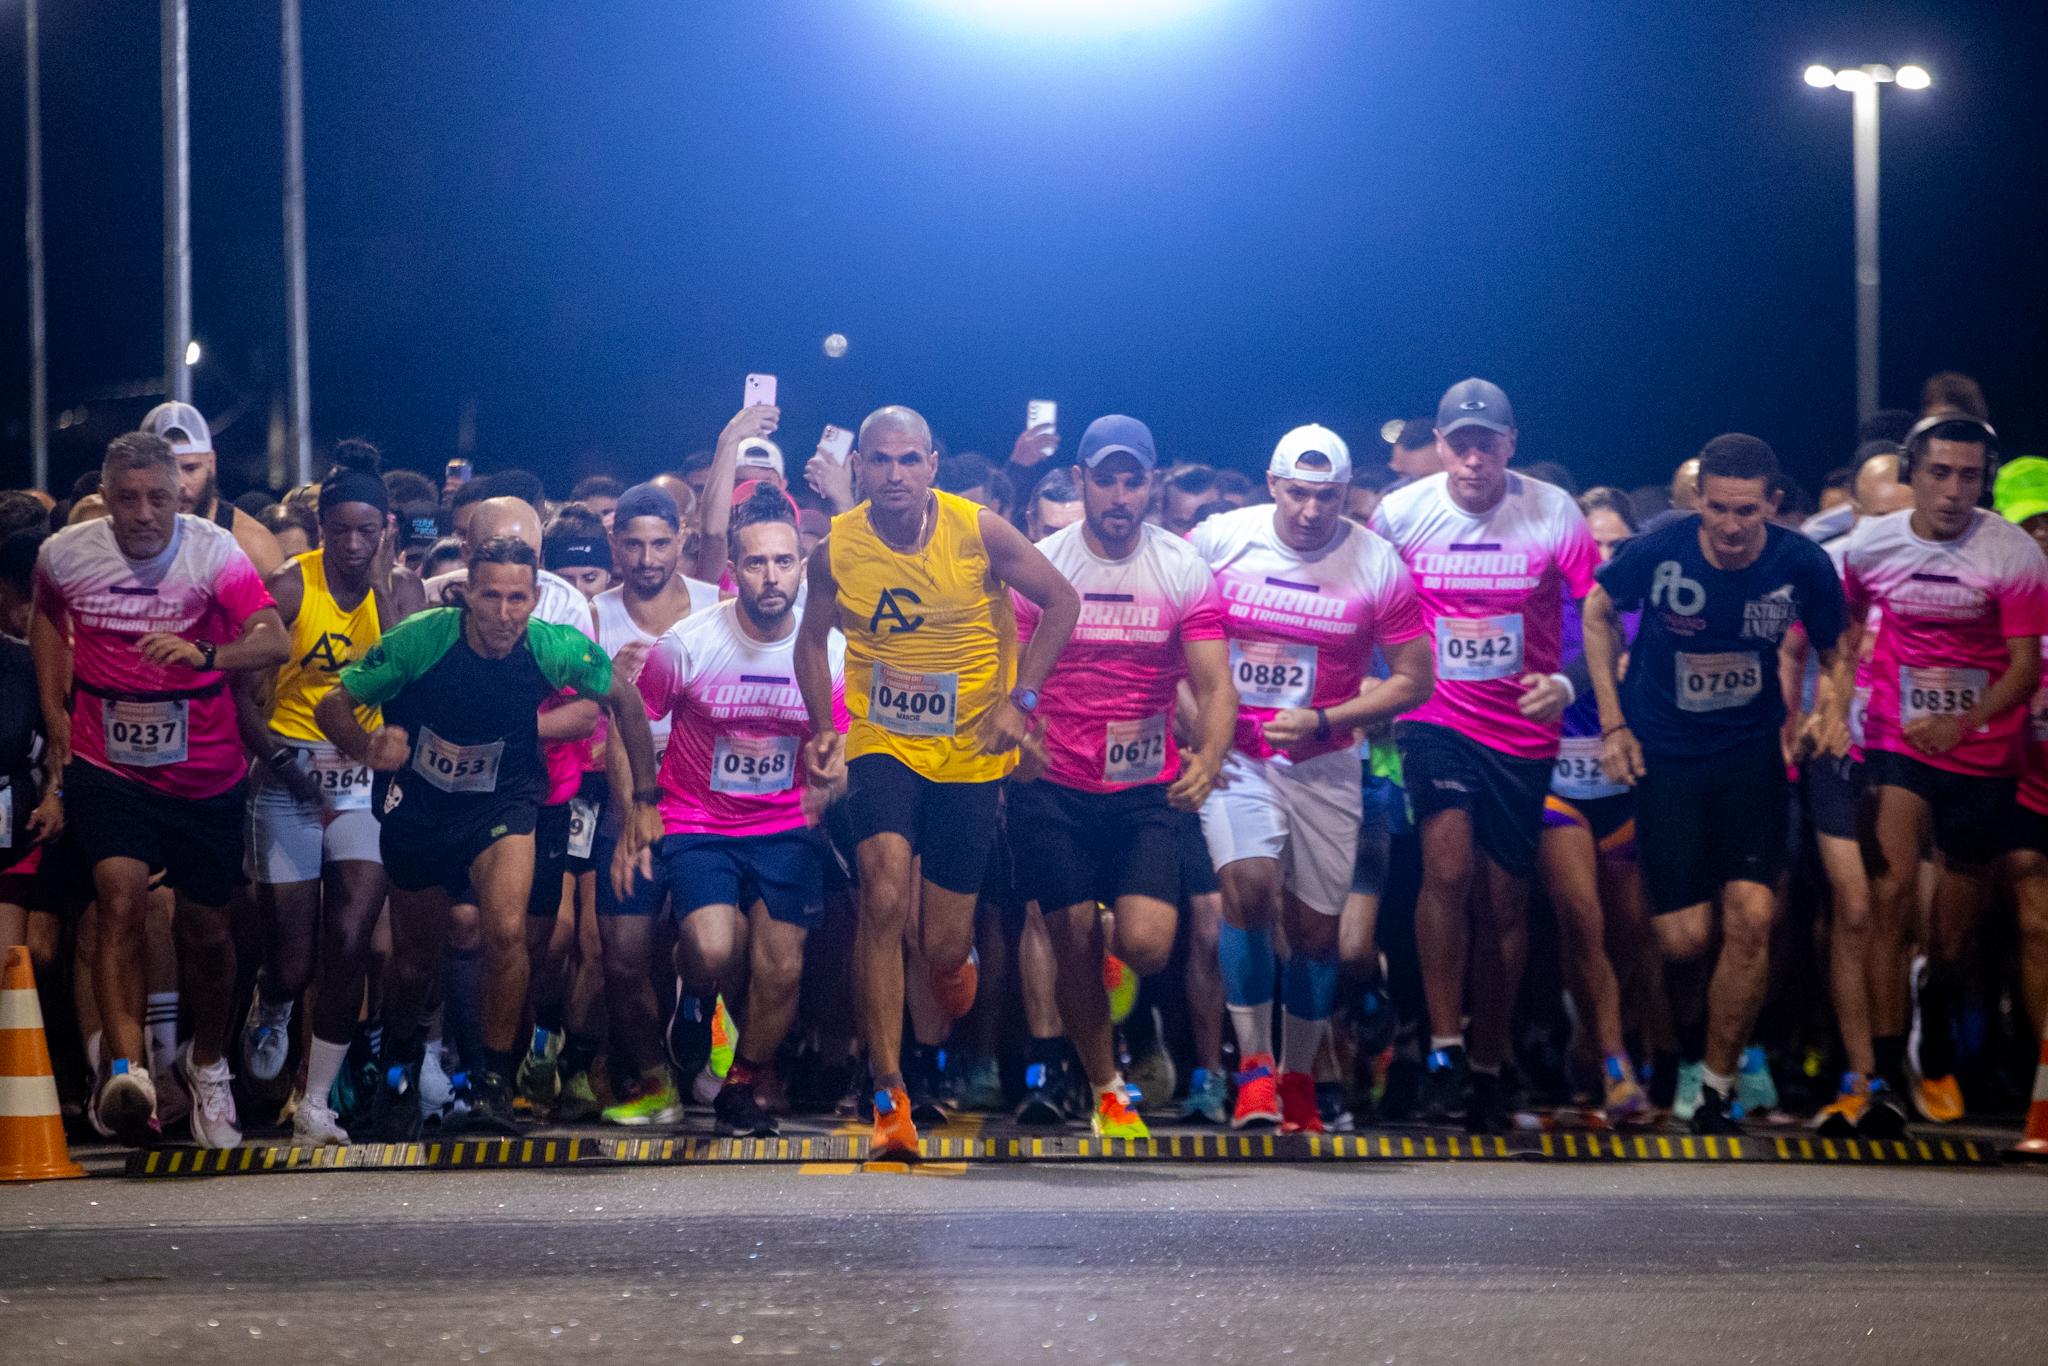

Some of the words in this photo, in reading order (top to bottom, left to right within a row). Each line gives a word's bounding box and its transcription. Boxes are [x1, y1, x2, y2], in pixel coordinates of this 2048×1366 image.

[1413, 553, 1529, 575] CORRIDA
[1222, 579, 1347, 620] CORRIDA
[1076, 604, 1160, 628] RRIDA
[1228, 603, 1251, 619] DO
[1251, 608, 1358, 635] TRABALHADOR
[1447, 636, 1513, 660] 0542
[1239, 661, 1304, 687] 0882
[1687, 668, 1758, 693] 0708
[710, 706, 730, 719] DO
[878, 685, 946, 716] 0400
[1911, 688, 1976, 712] 0838
[112, 721, 177, 746] 0237
[1109, 734, 1163, 765] 0672
[427, 749, 486, 778] 1053
[723, 753, 787, 776] 0368
[1558, 758, 1603, 779] 032
